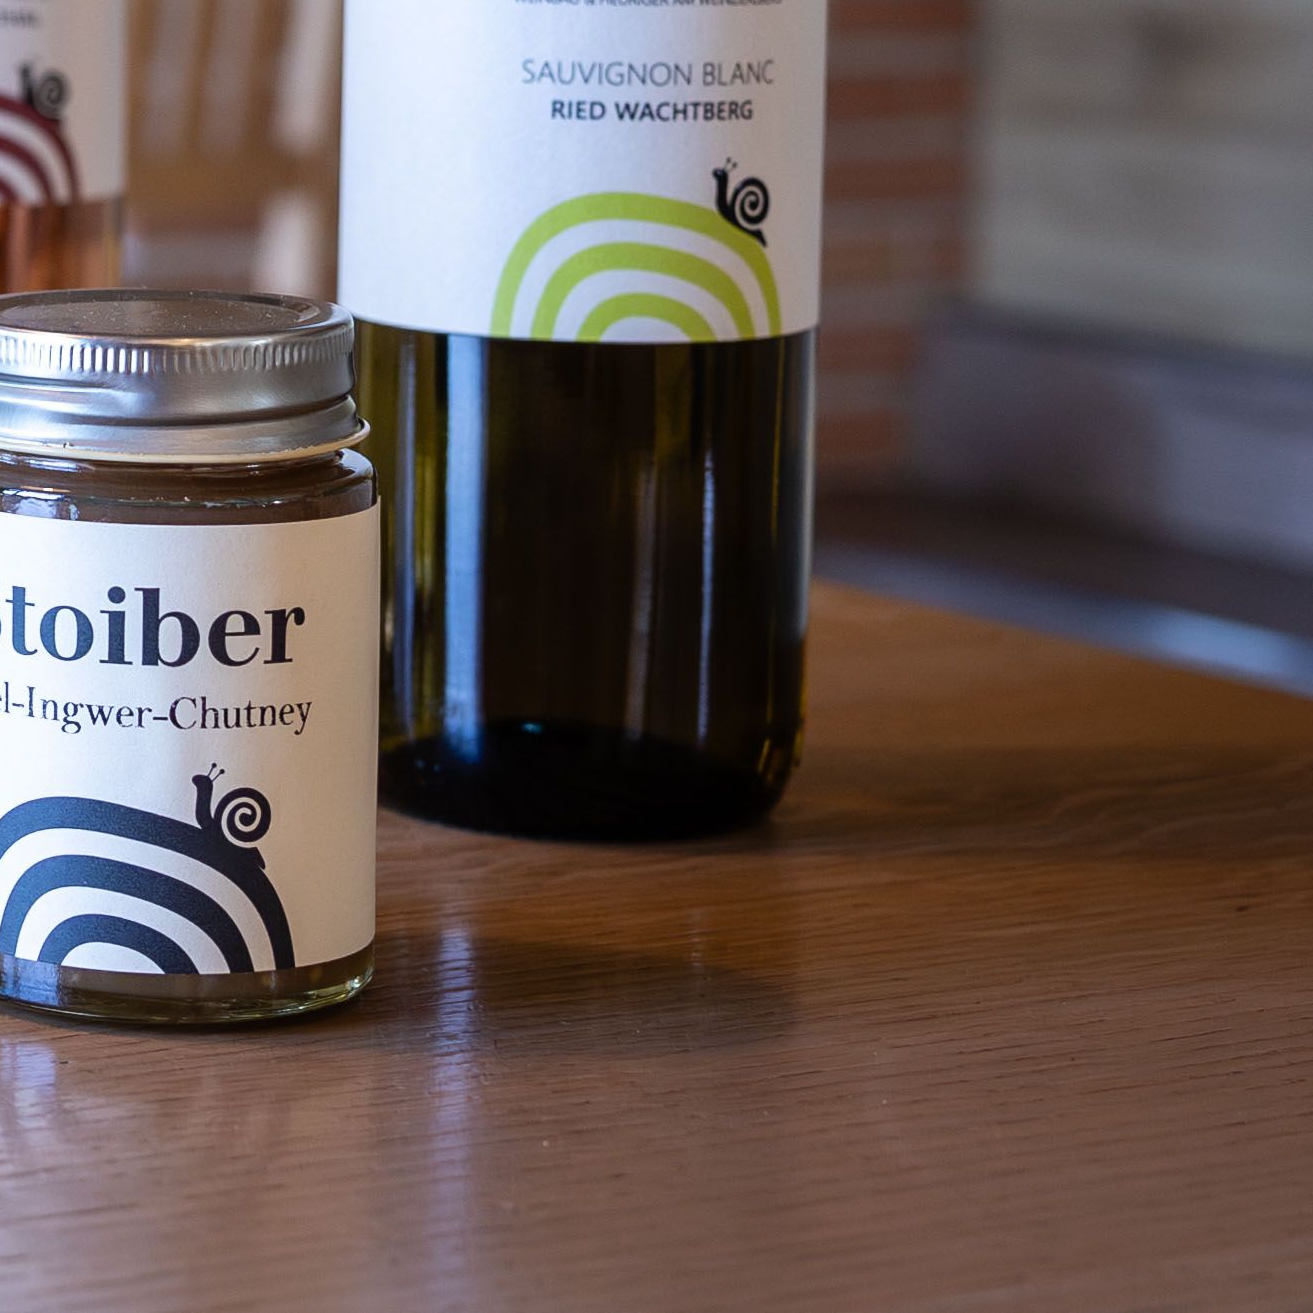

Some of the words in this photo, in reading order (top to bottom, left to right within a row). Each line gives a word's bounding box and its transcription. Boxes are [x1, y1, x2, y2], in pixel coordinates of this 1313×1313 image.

[522, 59, 693, 87] SAUVIGNON
[702, 59, 773, 87] BLANC
[551, 100, 607, 120] RIED
[615, 100, 753, 122] WACHTBERG
